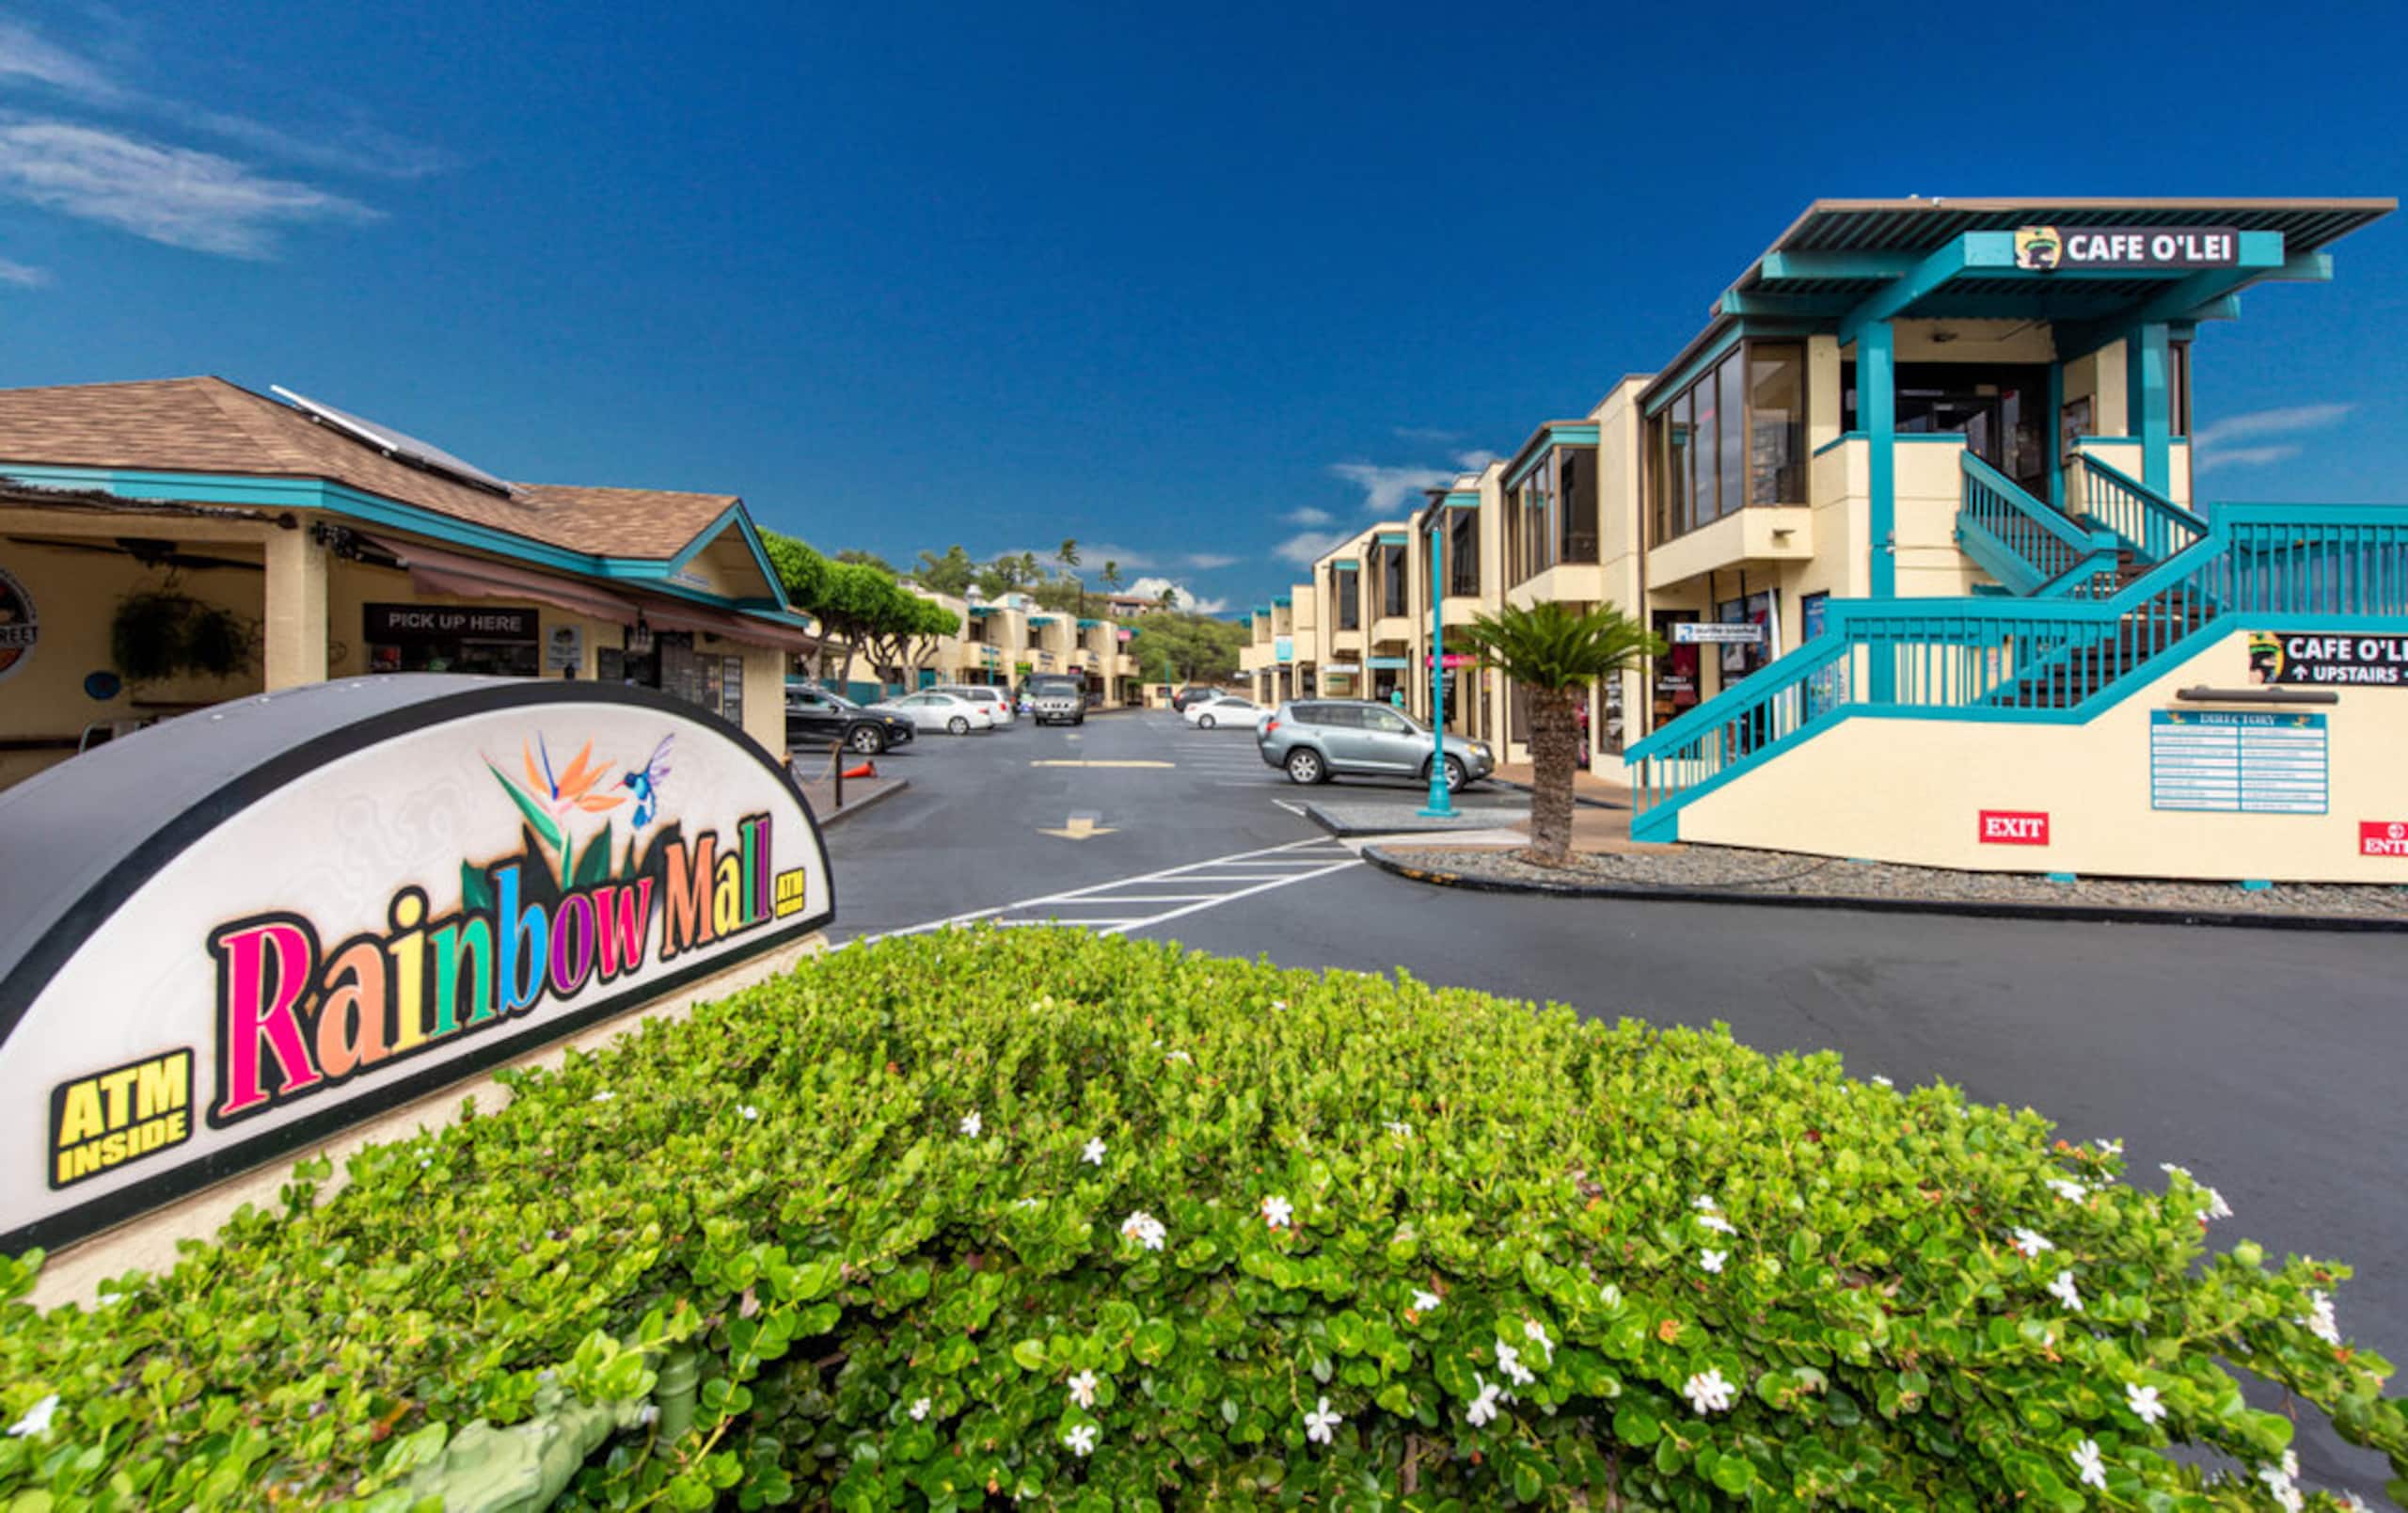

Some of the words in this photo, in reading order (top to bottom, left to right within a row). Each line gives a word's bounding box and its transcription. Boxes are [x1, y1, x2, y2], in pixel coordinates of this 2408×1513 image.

[2067, 233, 2145, 262] CAFE
[2150, 233, 2232, 262] O'LEI
[388, 613, 435, 629] PICK
[439, 613, 466, 630] UP
[470, 614, 522, 632] HERE
[2287, 636, 2352, 661] CAFE
[2313, 664, 2400, 683] UPSTAIRS
[2199, 712, 2277, 725] DIRECTORY
[1986, 817, 2044, 837] EXIT
[213, 860, 657, 1123] Rainbow
[660, 813, 771, 961] Mall
[58, 1051, 188, 1148] ATM
[57, 1109, 187, 1185] INSIDE
